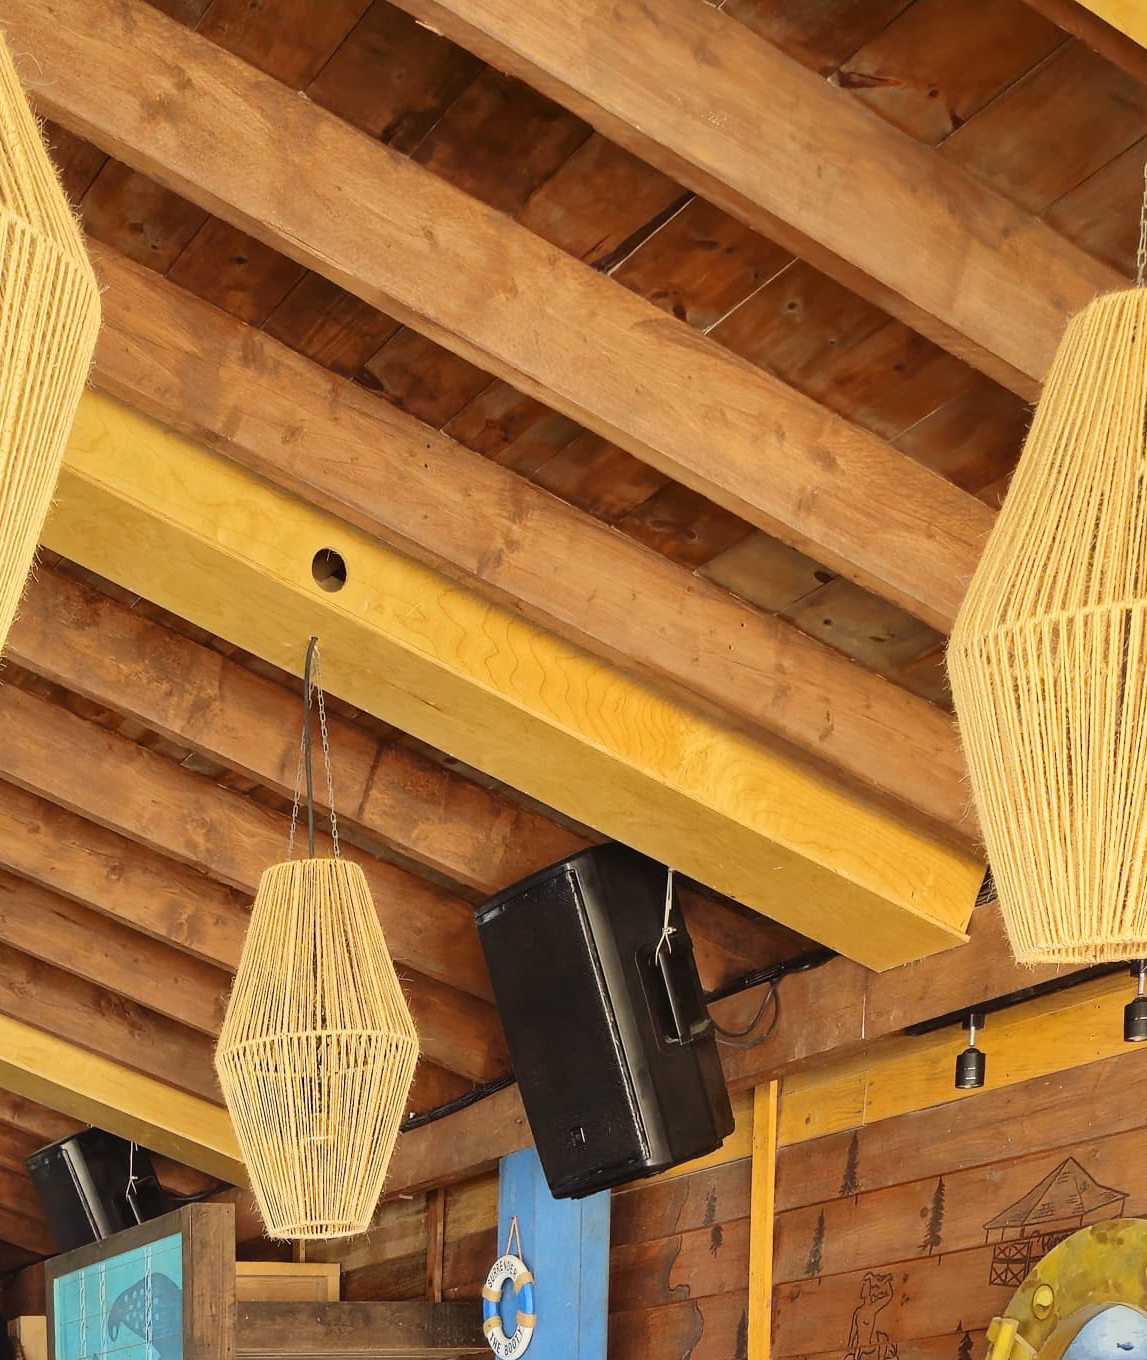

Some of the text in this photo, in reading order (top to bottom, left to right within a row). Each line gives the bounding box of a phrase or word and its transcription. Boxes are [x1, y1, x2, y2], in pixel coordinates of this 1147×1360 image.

[487, 1260, 518, 1288] SURRENDER
[490, 1326, 524, 1356] THE BOOTY
